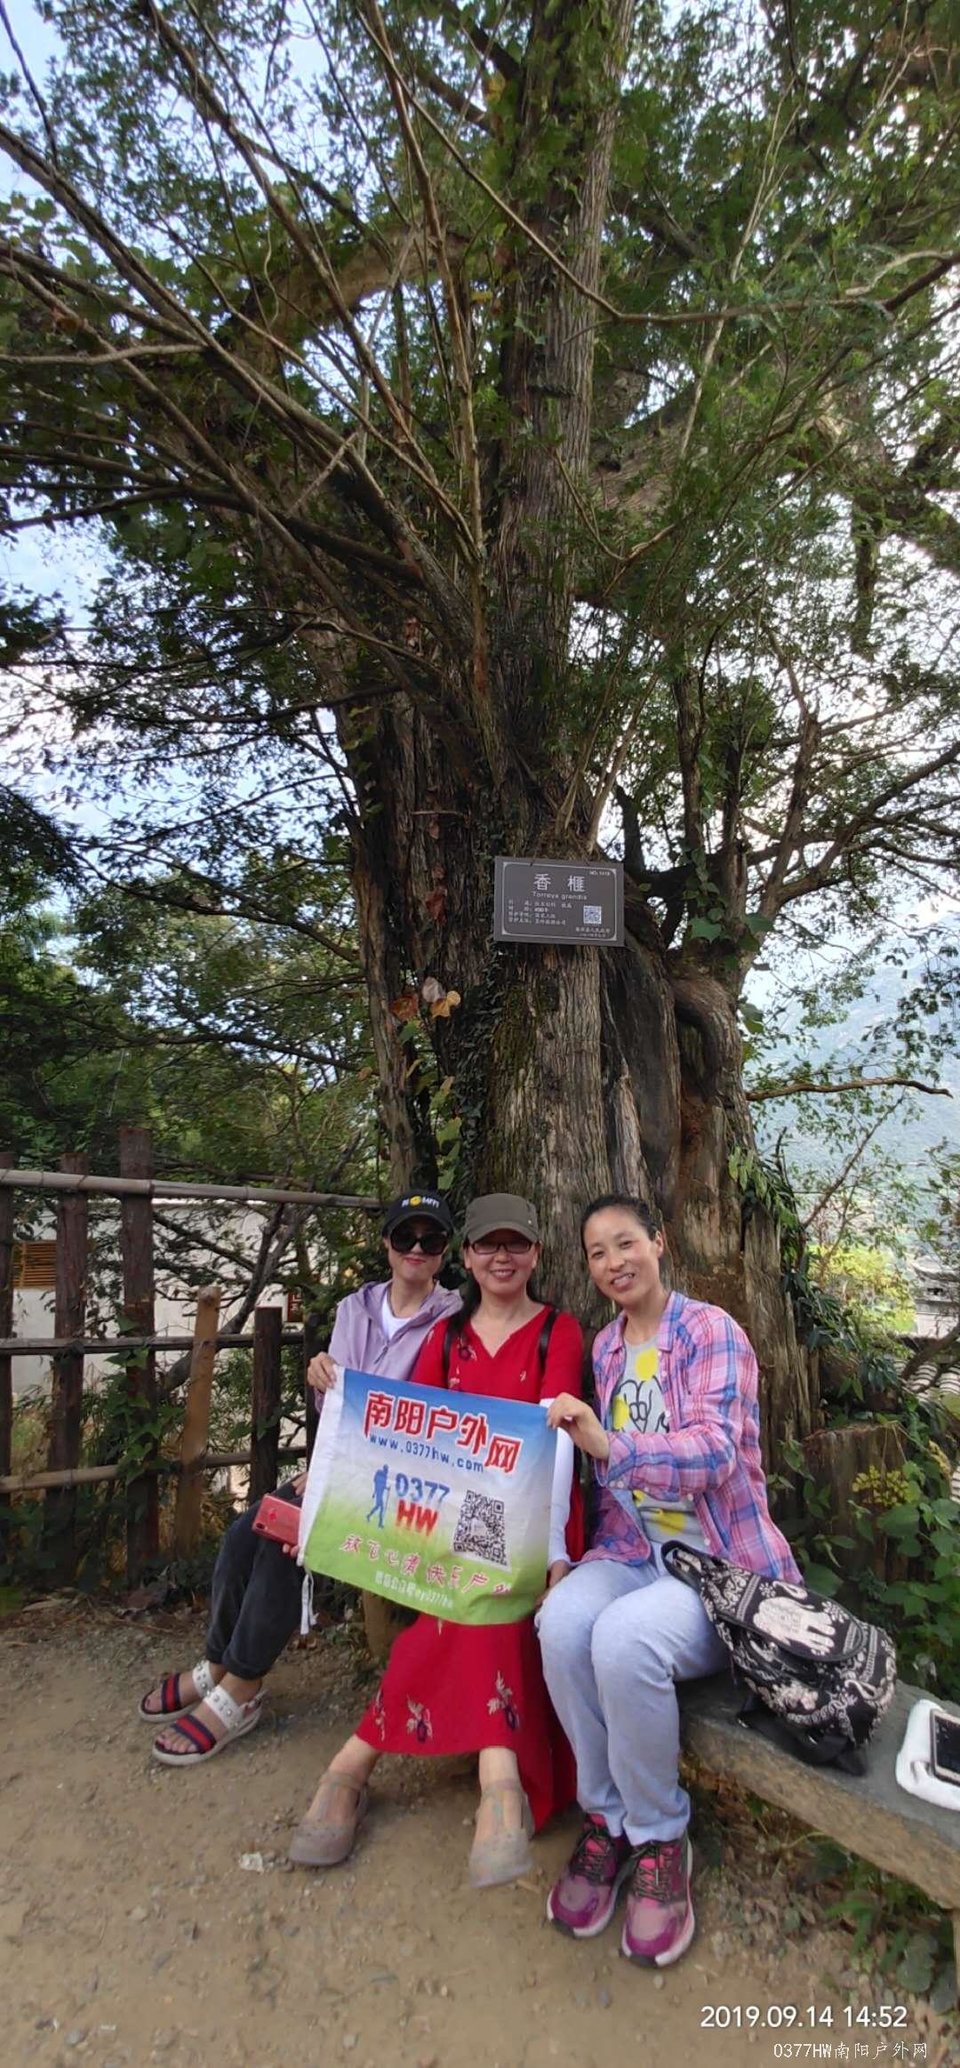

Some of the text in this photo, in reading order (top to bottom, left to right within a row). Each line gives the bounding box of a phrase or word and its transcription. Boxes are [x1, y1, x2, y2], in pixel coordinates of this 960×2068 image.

[364, 1390, 522, 1473] 南阳户外网
[369, 1434, 484, 1473] www.0377hw.com
[395, 1472, 450, 1505] 0377
[395, 1501, 439, 1536] HW
